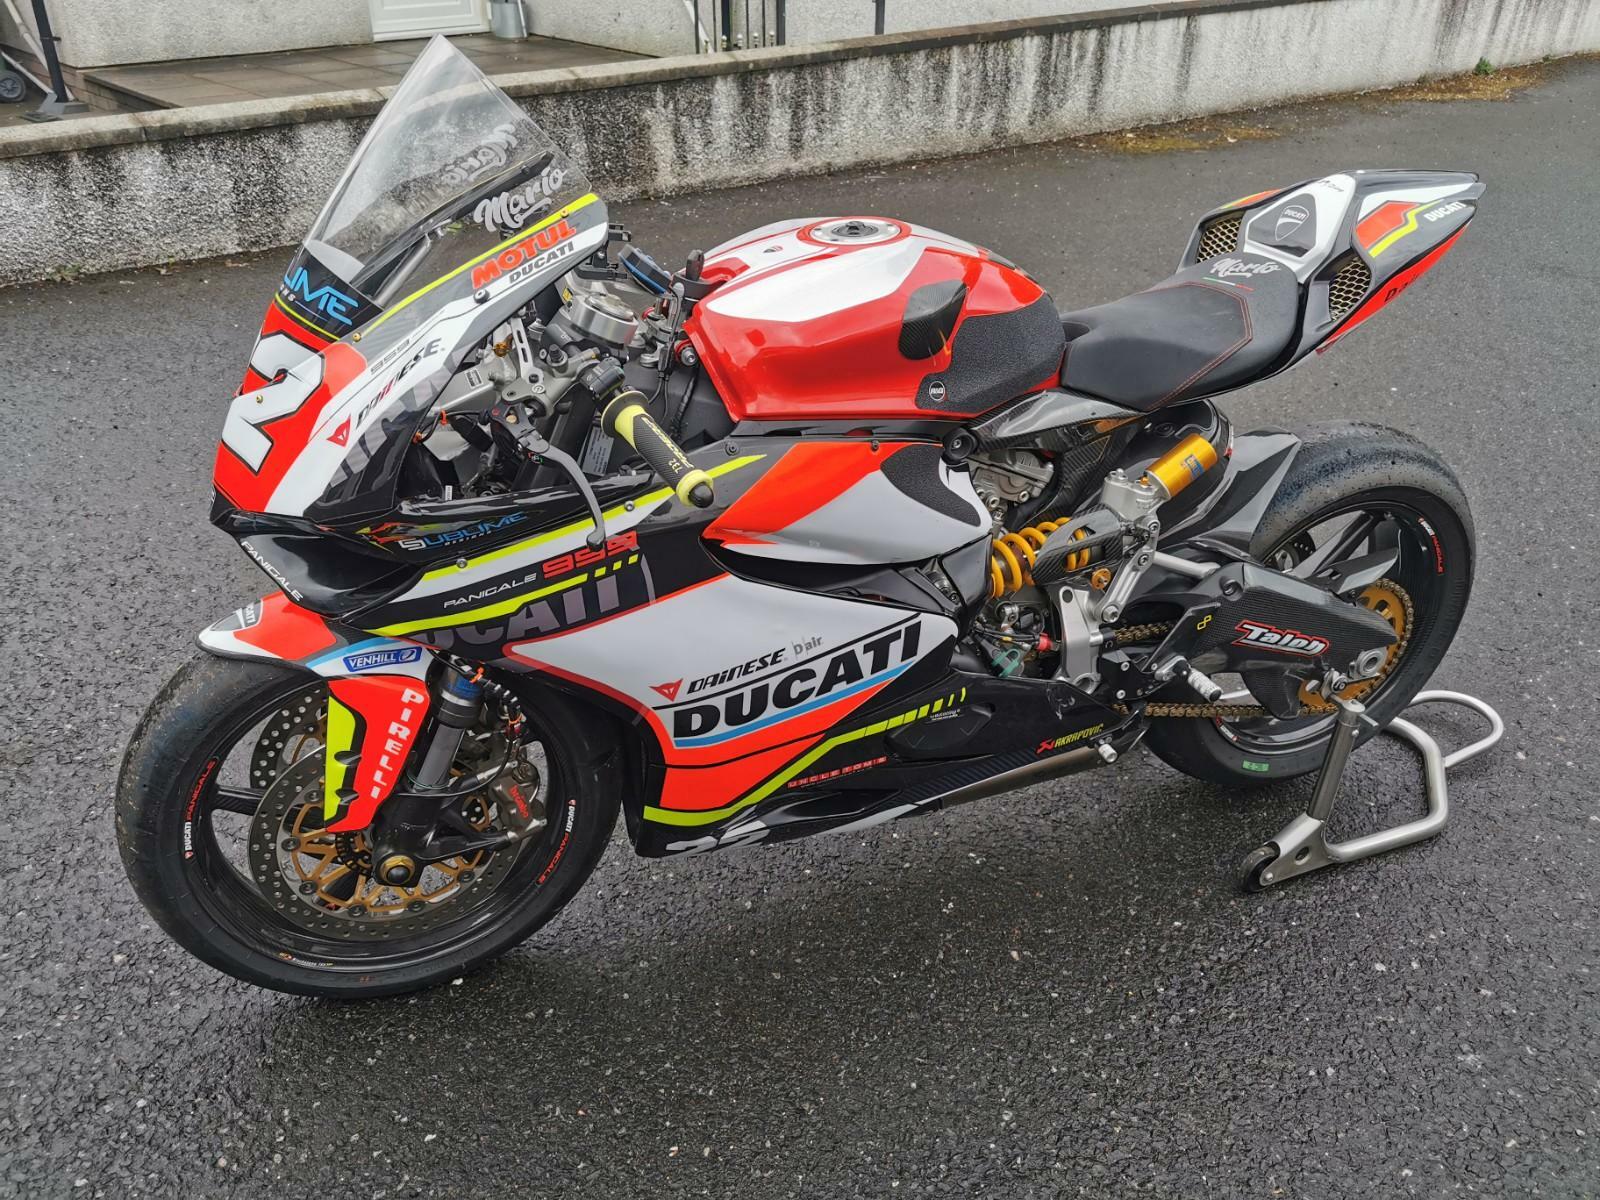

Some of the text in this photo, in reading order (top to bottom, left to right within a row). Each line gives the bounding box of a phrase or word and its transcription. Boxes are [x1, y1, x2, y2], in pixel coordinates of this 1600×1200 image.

[473, 165, 568, 232] Mario
[1284, 207, 1308, 220] DUCATI
[1424, 201, 1466, 222] DUCATI
[471, 219, 577, 289] MOTUL
[509, 240, 575, 284] DUCATI
[221, 330, 326, 477] 2
[398, 511, 528, 551] SUBLIME
[241, 541, 304, 601] PANIGALE
[443, 572, 538, 609] PANIGALE
[349, 651, 397, 669] VENHILL
[1242, 623, 1326, 655] Talon
[673, 620, 922, 738] DUCATI
[686, 647, 786, 696] DAINESE
[370, 688, 425, 800] PIRELLI
[565, 805, 576, 833] DUCATI
